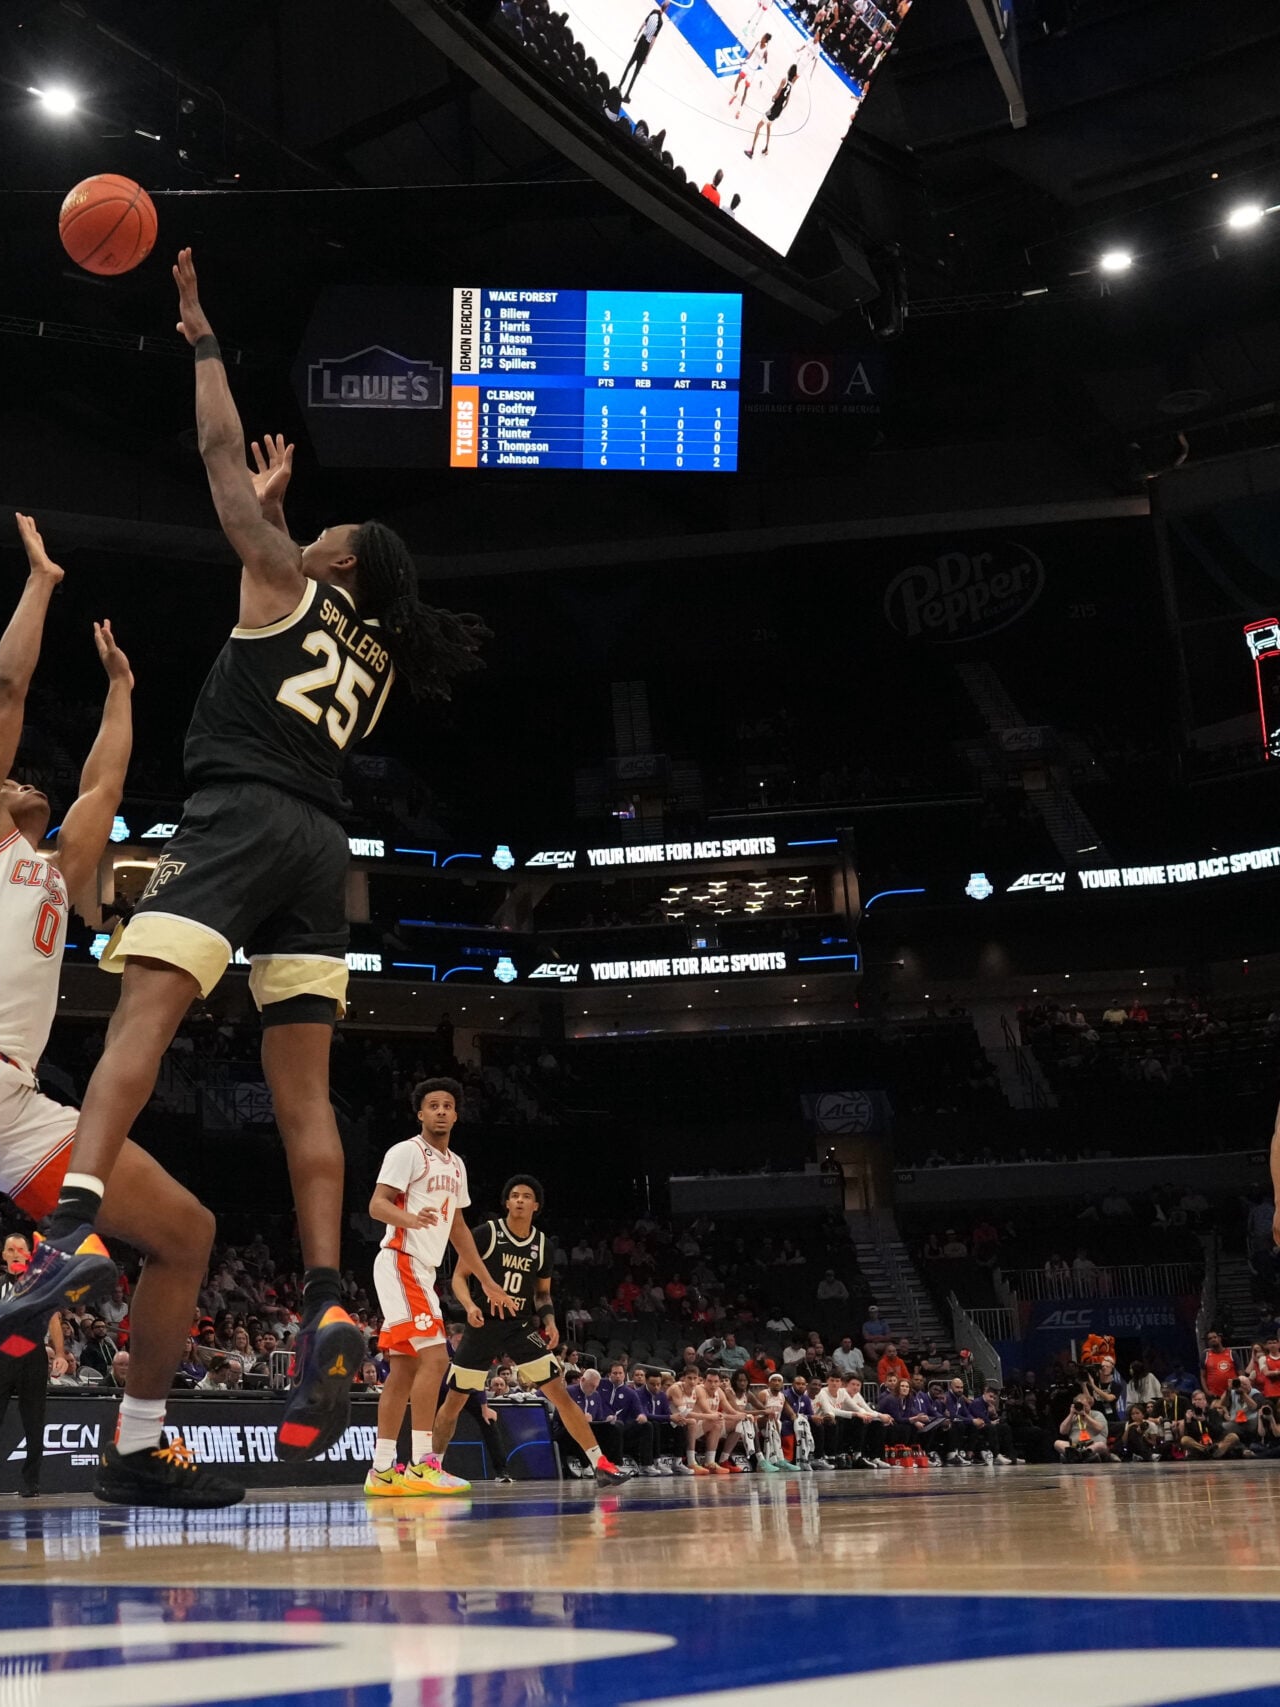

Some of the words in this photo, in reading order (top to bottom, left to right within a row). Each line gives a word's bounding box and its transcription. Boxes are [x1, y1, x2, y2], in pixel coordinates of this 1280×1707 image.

[490, 291, 518, 302] WAKE
[520, 292, 558, 302] FOREST
[460, 290, 473, 335] DEACONS
[485, 308, 490, 318] 0
[500, 308, 530, 319] Biliew
[604, 310, 610, 320] 3
[643, 311, 649, 322] 2
[680, 312, 687, 322] 0
[718, 313, 724, 323] 2
[484, 321, 490, 331] 2
[500, 321, 530, 332] Harris
[602, 324, 613, 334] 14
[643, 324, 649, 334] 0
[681, 326, 686, 335] 1
[717, 326, 724, 336] 0
[484, 334, 490, 343] 8
[500, 333, 532, 344] Mason
[604, 335, 610, 345] 0
[642, 336, 648, 346] 0
[681, 337, 686, 347] 1
[717, 338, 723, 347] 0
[460, 338, 472, 372] DEMON
[482, 346, 493, 355] 10
[499, 346, 527, 356] Akins
[604, 348, 610, 358] 2
[642, 348, 648, 358] 0
[681, 349, 686, 359] 1
[716, 350, 723, 360] 0
[481, 359, 493, 368] 25
[499, 359, 536, 371] Spillers
[603, 361, 609, 371] 5
[642, 361, 648, 371] 5
[679, 362, 685, 372] 2
[716, 363, 722, 373] 0
[323, 370, 429, 401] LOWE'S
[598, 379, 614, 387] PTS
[635, 379, 651, 388] REB
[674, 380, 691, 388] AST
[712, 381, 726, 389] FLS
[487, 390, 534, 400] CLEMSON
[483, 403, 489, 413] 0
[498, 403, 536, 416] Godfrey
[602, 406, 608, 416] 6
[640, 406, 646, 416] 4
[679, 407, 684, 417] 1
[716, 408, 720, 418] 1
[456, 401, 473, 455] TIGERS
[484, 416, 488, 426] 1
[498, 416, 529, 426] Porter
[602, 418, 608, 428] 3
[641, 419, 646, 429] 1
[678, 419, 684, 430] 0
[714, 420, 721, 430] 0
[482, 428, 488, 438] 2
[498, 428, 531, 438] Hunter
[602, 430, 608, 440] 2
[641, 431, 646, 441] 1
[677, 431, 684, 441] 2
[714, 432, 720, 442] 0
[482, 441, 488, 450] 3
[498, 441, 548, 454] Thompson
[601, 443, 607, 453] 7
[640, 443, 645, 453] 1
[677, 444, 683, 454] 0
[714, 444, 720, 454] 0
[482, 454, 488, 463] 4
[497, 454, 539, 464] Johnson
[601, 456, 607, 466] 6
[640, 456, 645, 466] 1
[676, 457, 683, 467] 0
[713, 457, 720, 467] 2
[937, 553, 992, 593] Dr
[901, 563, 1030, 637] Pepper
[320, 598, 389, 673] SPILLERS
[275, 629, 376, 750] 25
[526, 850, 576, 867] ACCN
[587, 848, 624, 866] YOUR
[625, 845, 664, 864] HOME
[666, 843, 694, 861] FOR
[694, 840, 723, 859] ACC
[722, 837, 776, 857] SPORTS
[1008, 872, 1065, 891] ACCN
[1078, 868, 1121, 889] YOUR
[1121, 866, 1167, 887] HOME
[1167, 862, 1199, 884] FOR
[1199, 856, 1230, 880] ACC
[33, 900, 61, 958] 0
[529, 963, 579, 979] ACCN
[591, 962, 629, 980] YOUR
[631, 960, 671, 978] HOME
[673, 958, 701, 976] FOR
[700, 956, 729, 974] ACC
[730, 952, 786, 972] SPORTS
[824, 1103, 868, 1117] ACC
[440, 1196, 450, 1223] 4
[502, 1253, 533, 1272] WAKE
[503, 1270, 523, 1293] 10
[1042, 1309, 1093, 1329] ACC
[183, 1426, 241, 1463] HOME
[71, 1454, 99, 1466] ESPN
